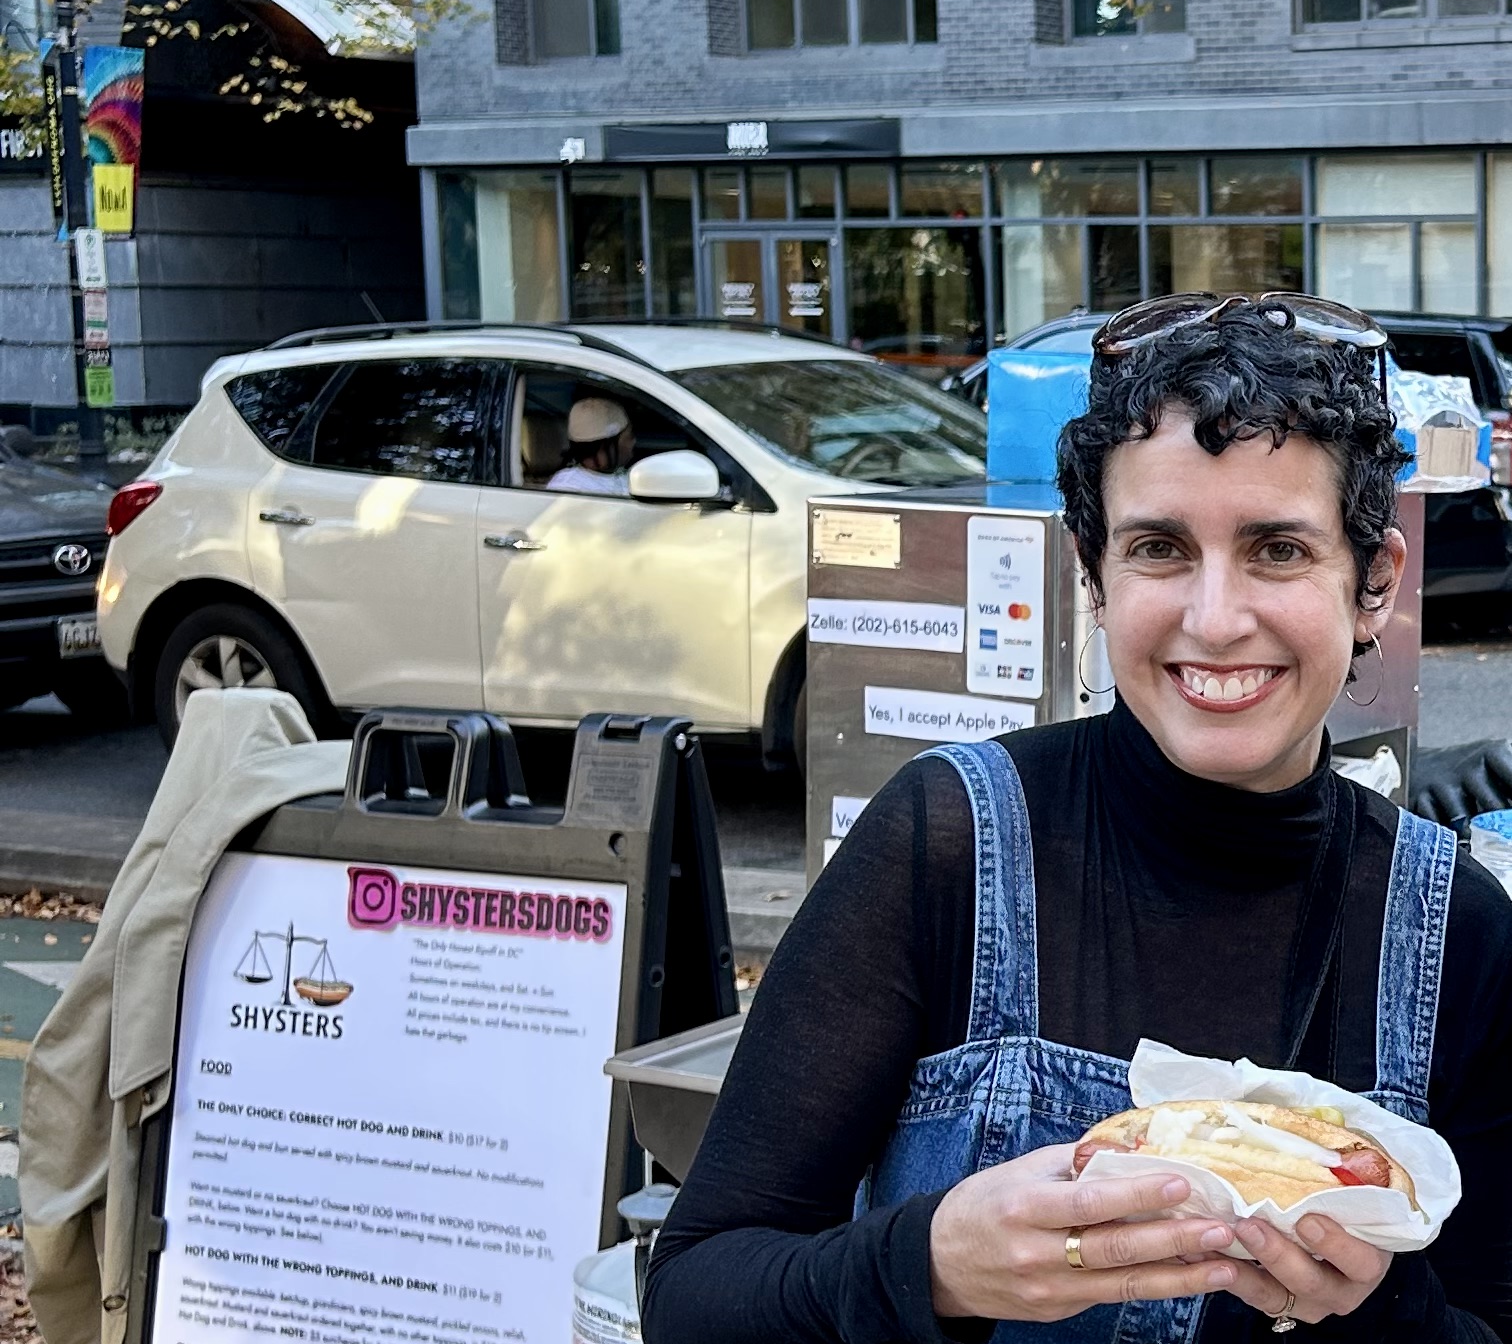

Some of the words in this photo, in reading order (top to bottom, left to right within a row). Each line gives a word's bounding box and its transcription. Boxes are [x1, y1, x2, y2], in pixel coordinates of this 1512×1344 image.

[978, 604, 1000, 615] VISA
[810, 614, 847, 630] Zelle:
[852, 615, 958, 637] (202)-615-6043
[869, 705, 894, 724] Yes,
[900, 707, 903, 721] I
[908, 711, 950, 729] accept
[956, 712, 996, 732] Apple
[401, 883, 611, 939] SHYSTERSDOGS
[230, 1004, 344, 1040] SHYSTERS
[200, 1058, 232, 1076] FOOD
[198, 1099, 215, 1111] THE
[218, 1101, 244, 1115] ONLY
[289, 1111, 334, 1128] CORRECT
[337, 1117, 358, 1130] HOT
[361, 1120, 384, 1134] DOG
[386, 1124, 409, 1137] AND
[412, 1126, 443, 1142] DRINK
[186, 1244, 205, 1256] HOT
[208, 1247, 230, 1261] DOG
[233, 1252, 258, 1265] WITH
[262, 1255, 279, 1269] THE
[283, 1259, 322, 1275] WRONG
[381, 1274, 404, 1288] AND
[407, 1278, 438, 1293] DRINK
